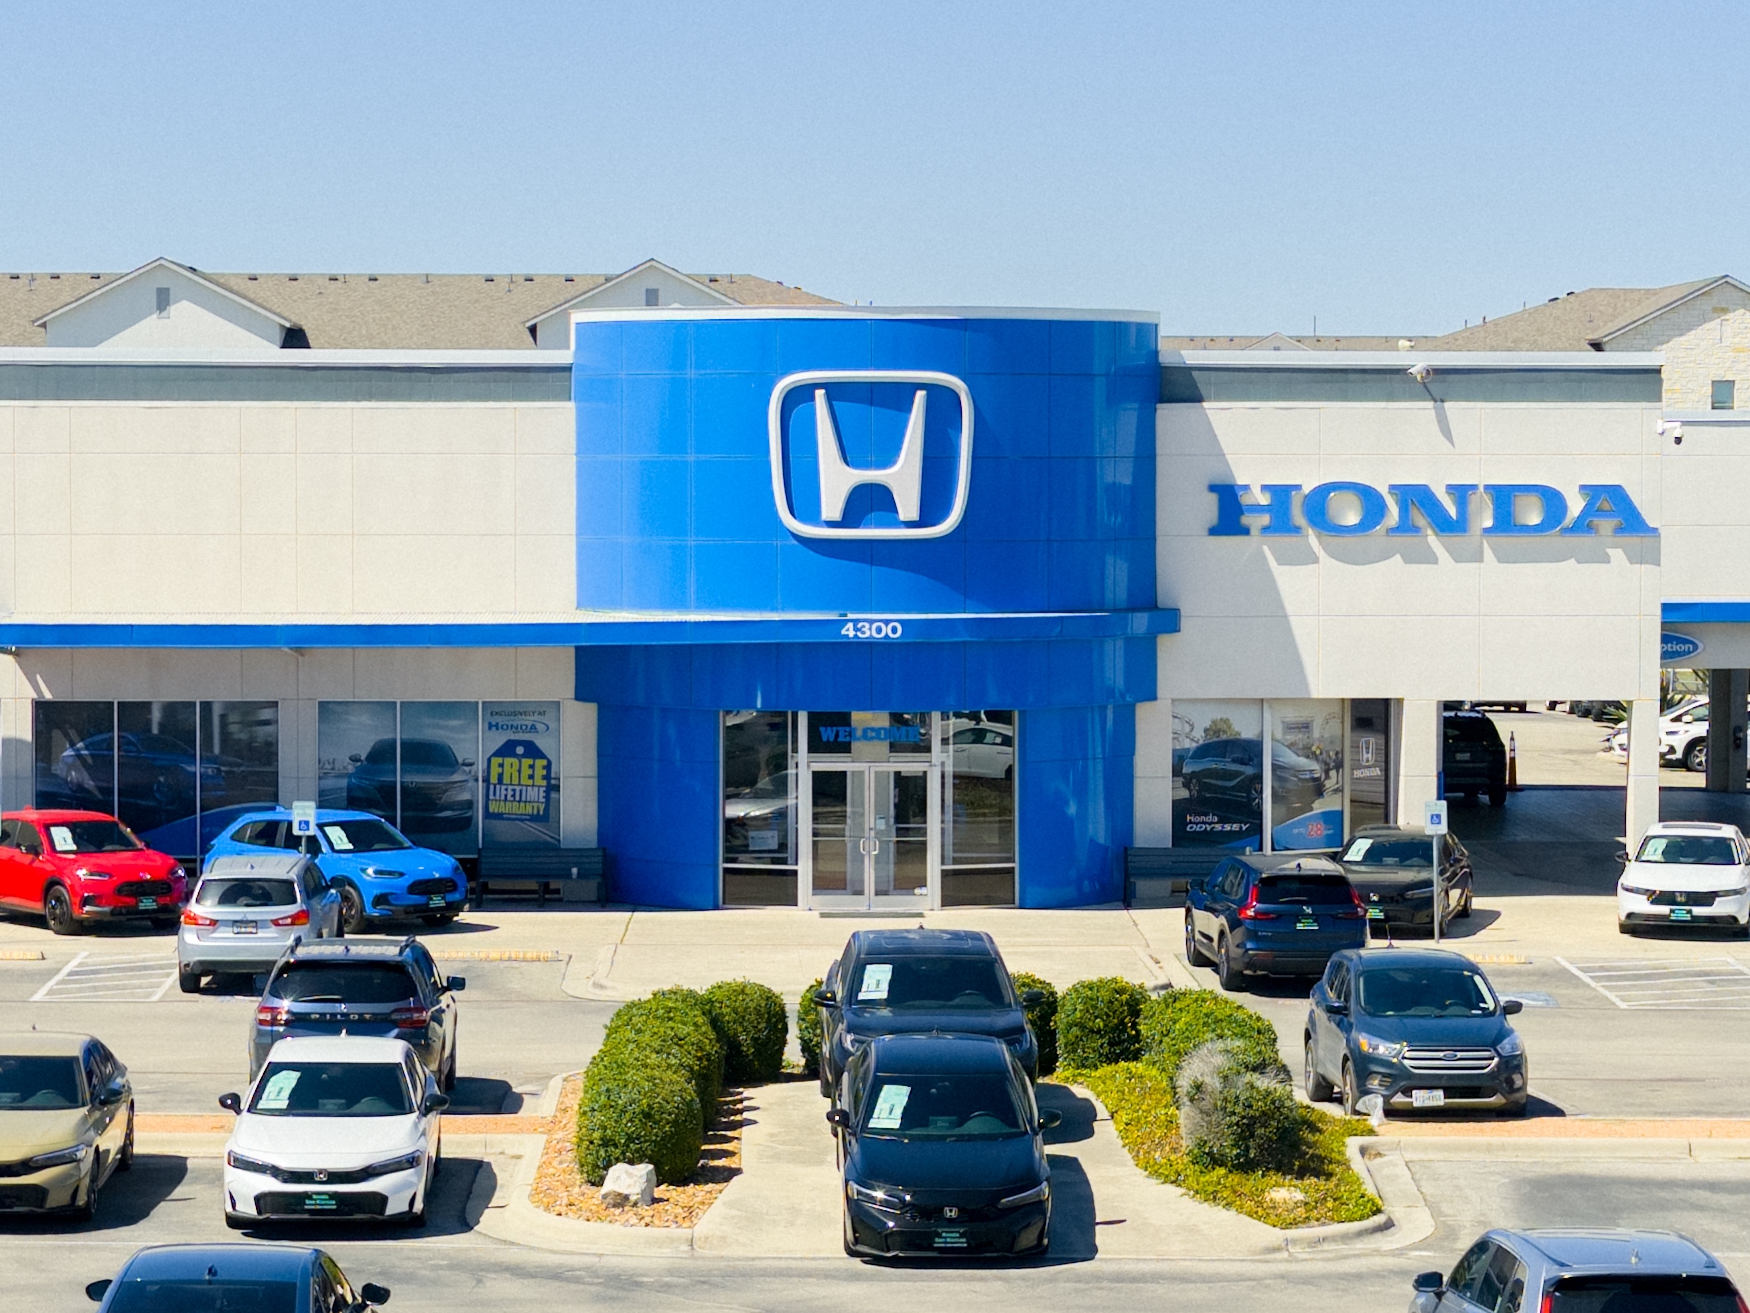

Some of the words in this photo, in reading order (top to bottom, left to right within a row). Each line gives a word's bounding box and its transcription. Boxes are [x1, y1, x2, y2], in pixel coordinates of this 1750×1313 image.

[1207, 481, 1659, 537] HONDA
[840, 621, 902, 638] 4300
[1661, 640, 1693, 652] tion
[490, 710, 536, 718] EXCLUSIVELY
[488, 721, 538, 732] HONDA
[819, 726, 921, 743] WELCOME
[490, 756, 548, 786] FREE
[489, 784, 546, 802] LIFETIME
[488, 800, 546, 816] WARRANTY
[1186, 814, 1218, 822] Honda
[1186, 823, 1250, 832] ODYSSEY
[1306, 822, 1324, 838] 28
